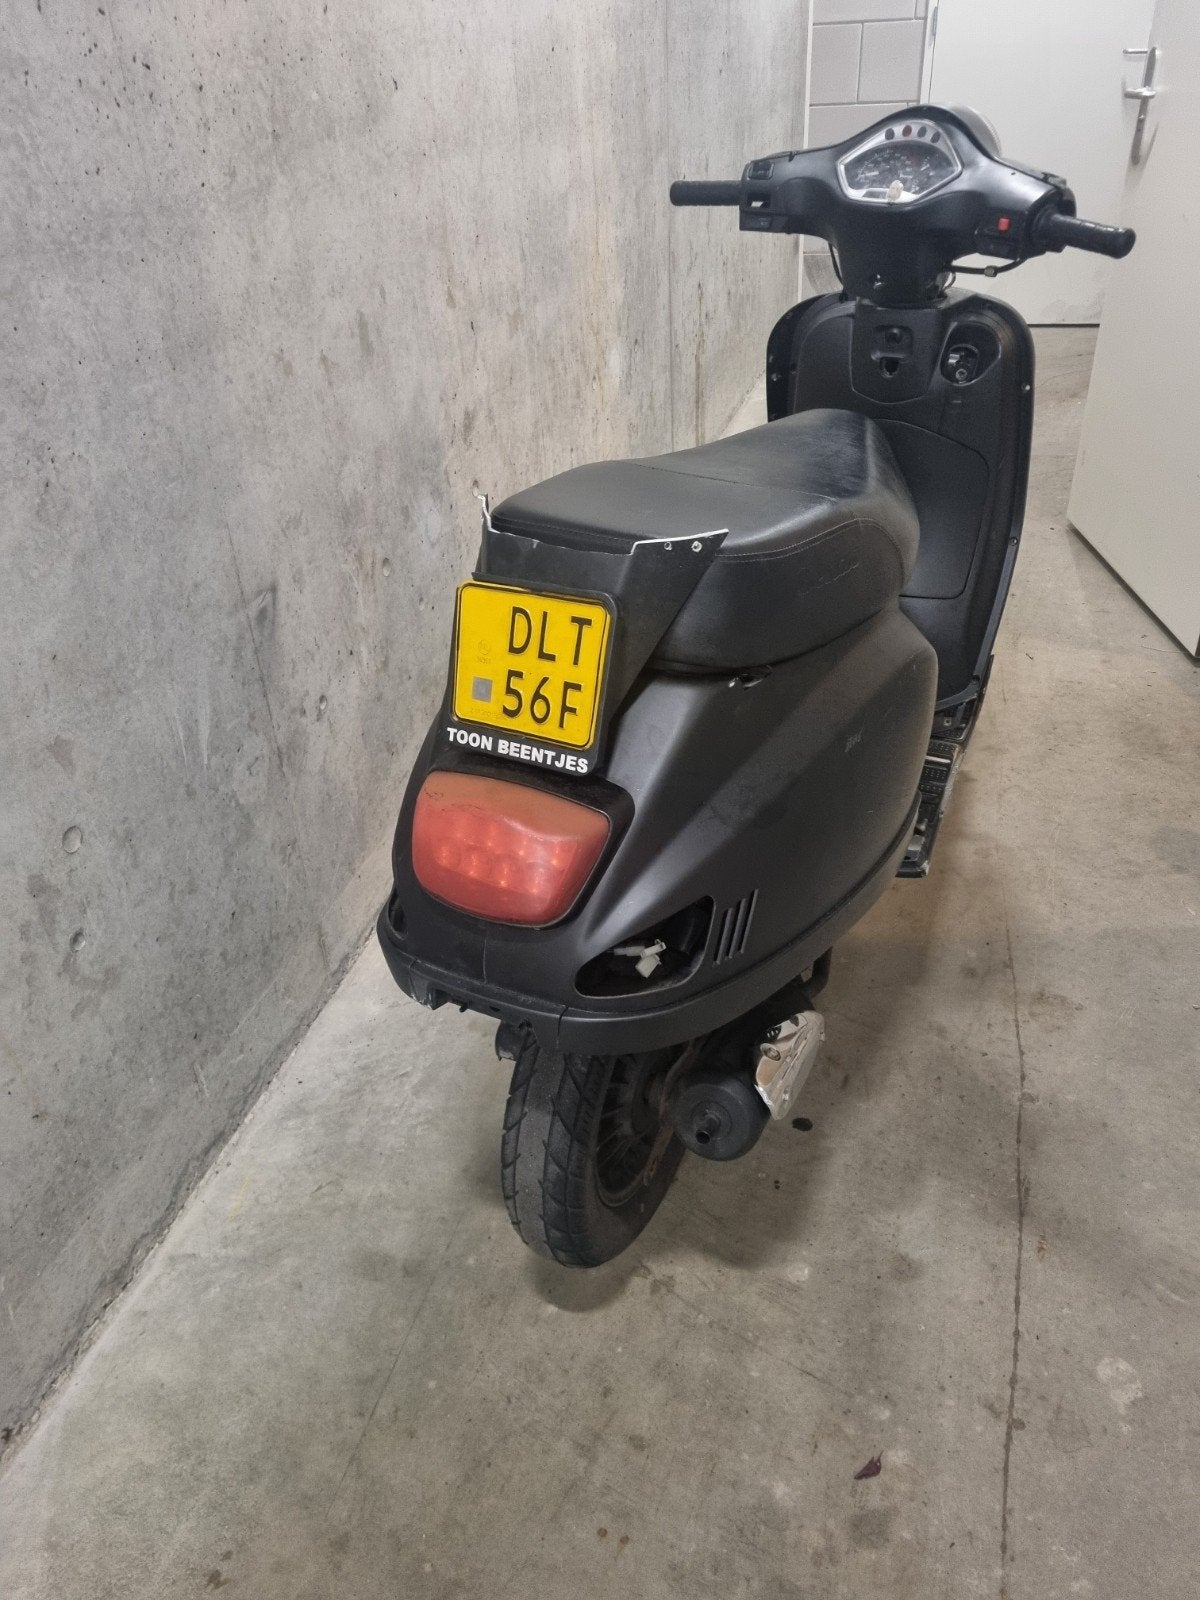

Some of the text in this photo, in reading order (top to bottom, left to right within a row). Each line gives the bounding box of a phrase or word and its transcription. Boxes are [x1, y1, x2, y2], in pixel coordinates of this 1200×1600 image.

[508, 606, 592, 666] DLT
[502, 669, 582, 729] 56F
[447, 727, 589, 774] TOON BEENTJES
